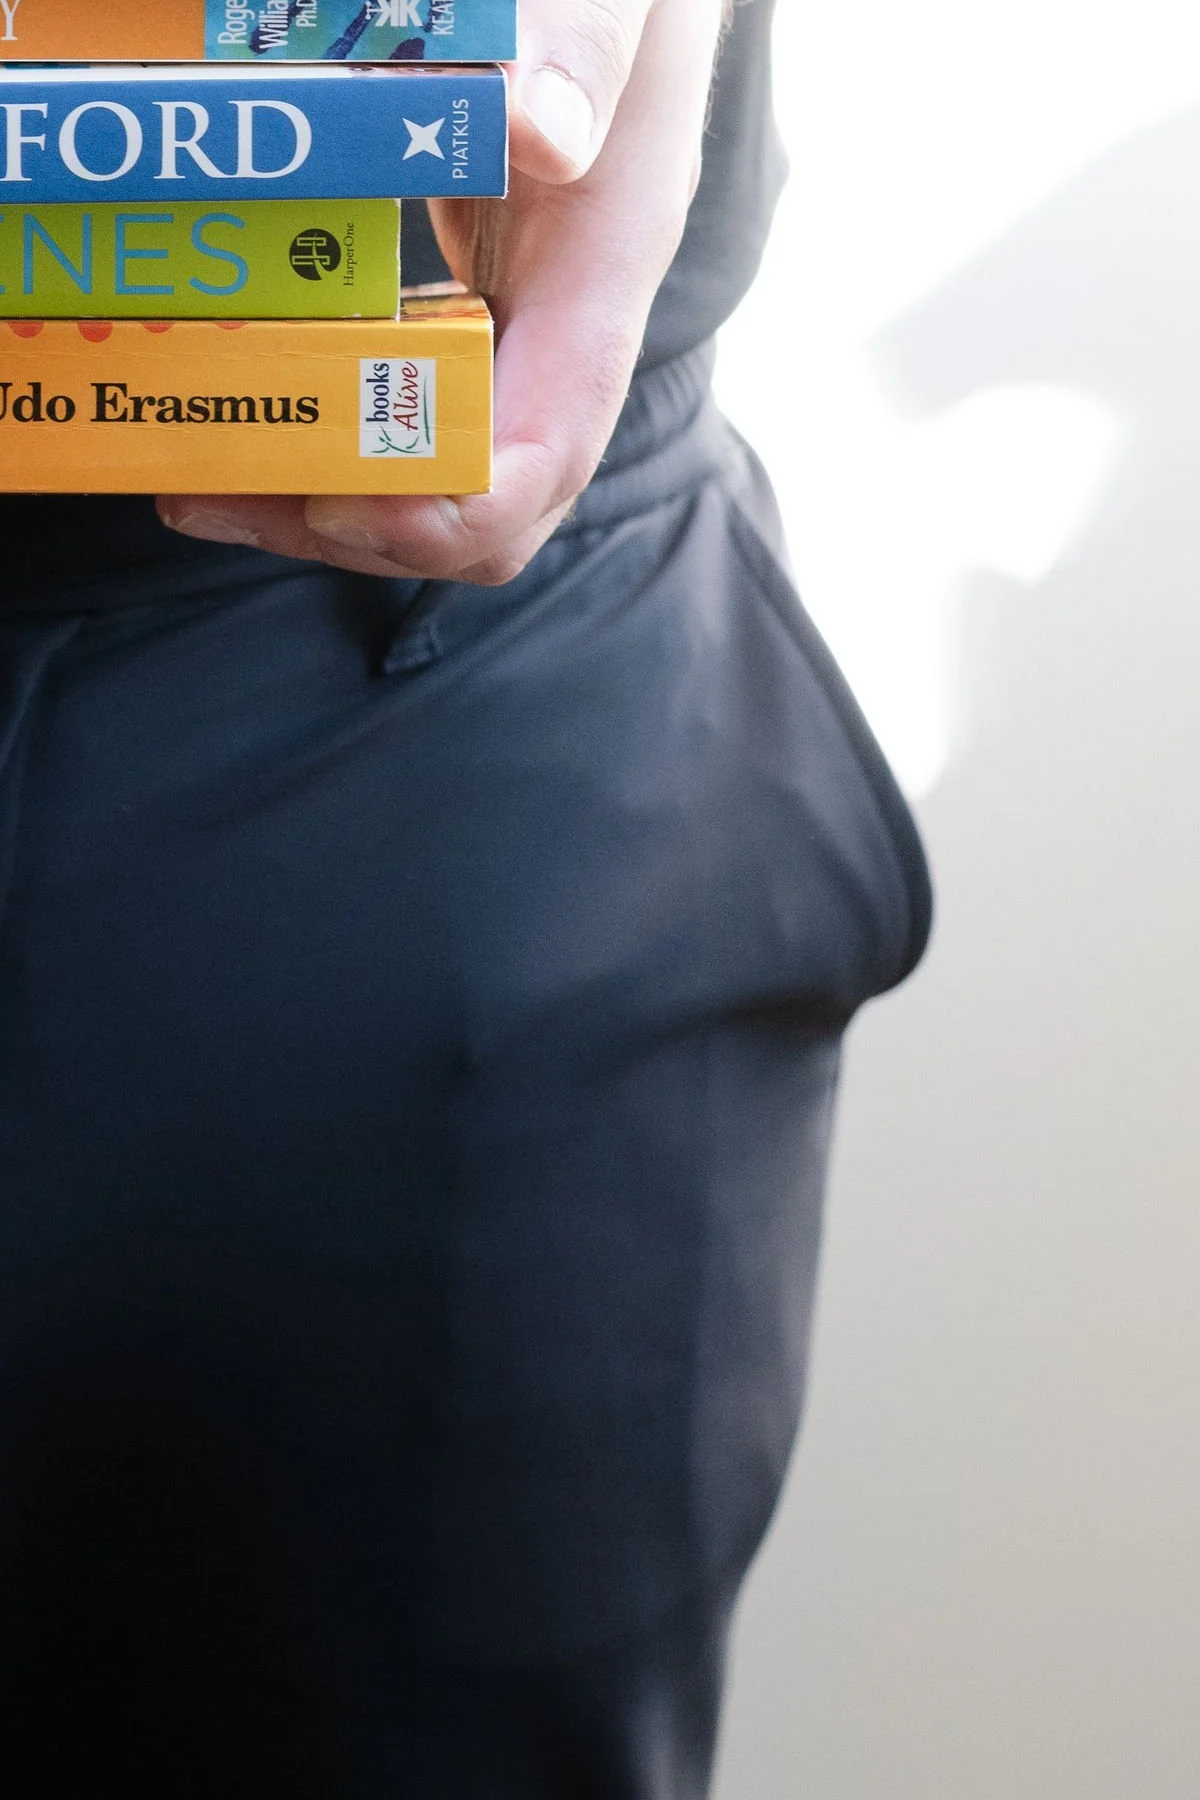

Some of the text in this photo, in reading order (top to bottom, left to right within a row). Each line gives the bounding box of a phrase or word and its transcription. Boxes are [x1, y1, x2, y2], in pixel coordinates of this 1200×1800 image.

[452, 98, 469, 179] PIATKUS
[343, 222, 357, 286] HarperOne
[91, 384, 320, 424] Erasmus
[366, 362, 390, 422] books
[393, 361, 418, 431] Alive
